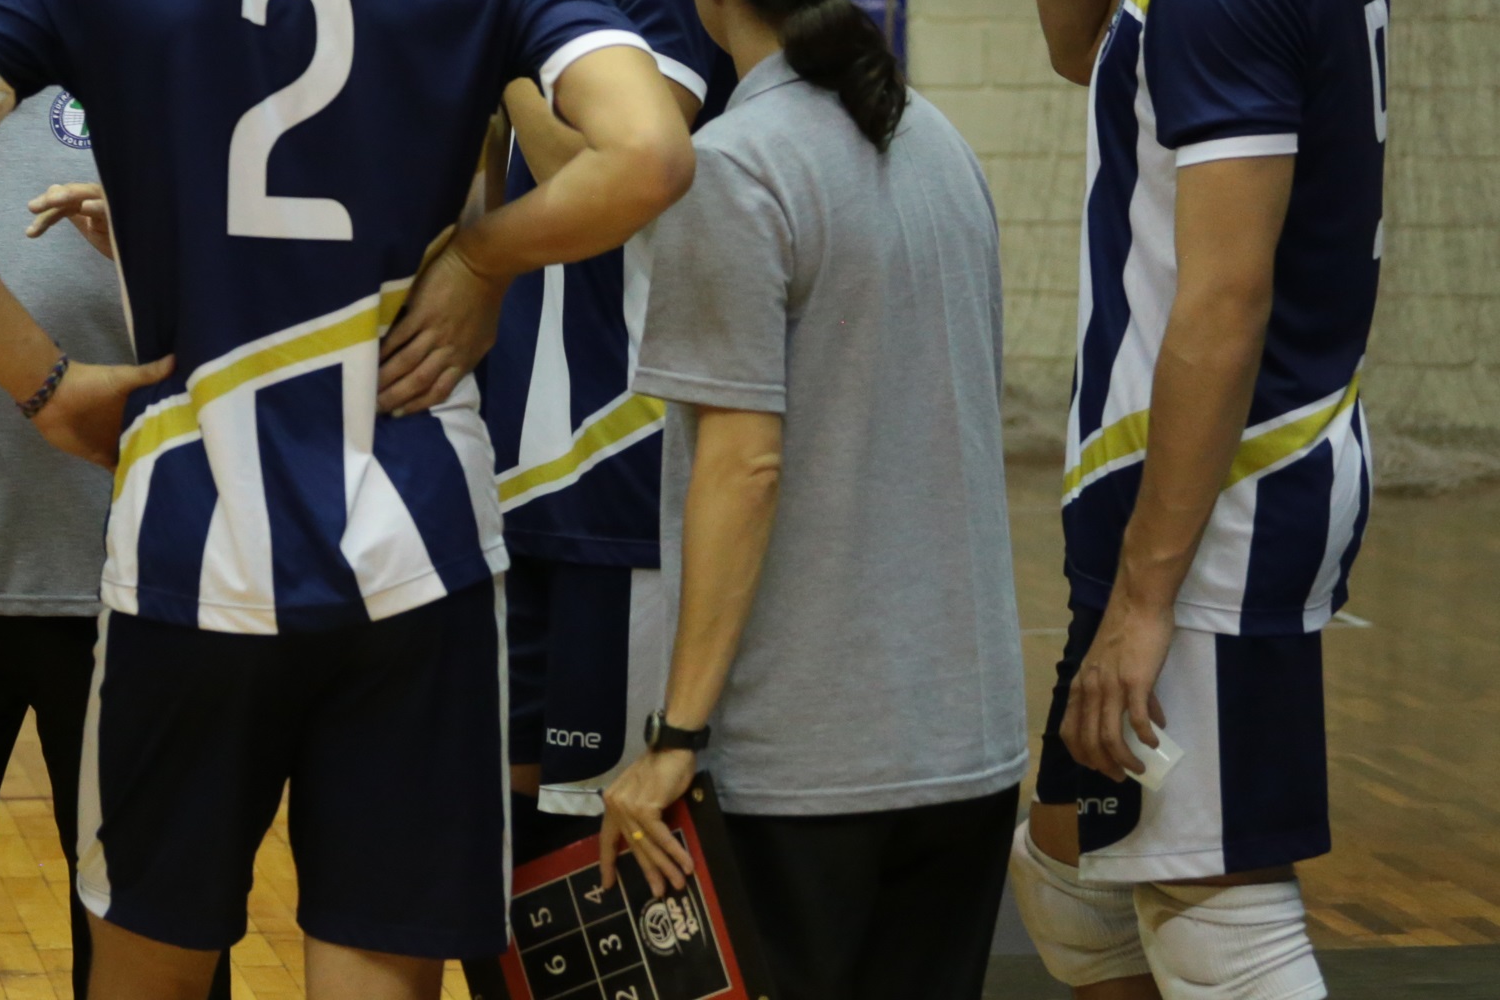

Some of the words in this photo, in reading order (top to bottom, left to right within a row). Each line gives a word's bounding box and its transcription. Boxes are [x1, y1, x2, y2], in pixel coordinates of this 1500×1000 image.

[584, 884, 604, 905] 4
[529, 906, 553, 929] 5
[599, 933, 623, 956] 3
[544, 954, 567, 976] 6
